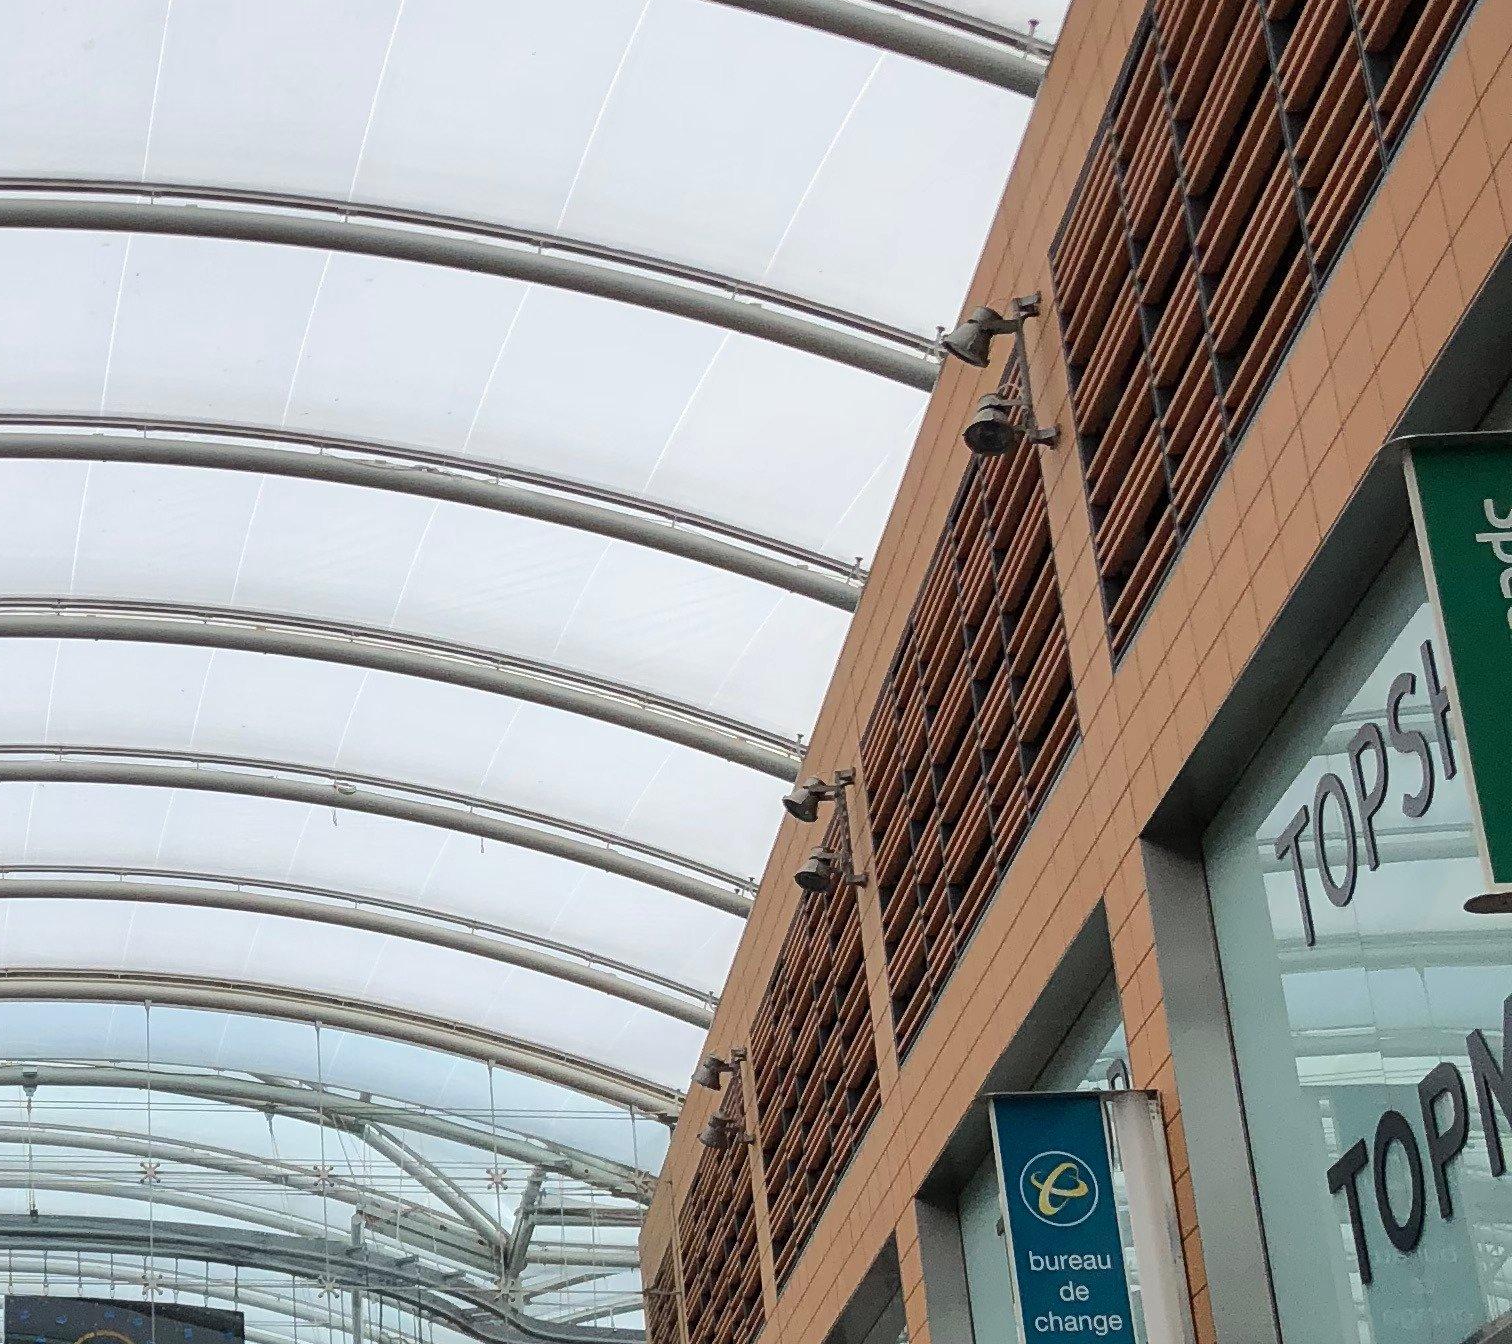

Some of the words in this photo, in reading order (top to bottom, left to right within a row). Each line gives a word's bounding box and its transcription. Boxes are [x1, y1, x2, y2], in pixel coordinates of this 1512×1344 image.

[1029, 1251, 1112, 1271] bureau
[1060, 1282, 1090, 1302] de
[1034, 1311, 1123, 1337] change
